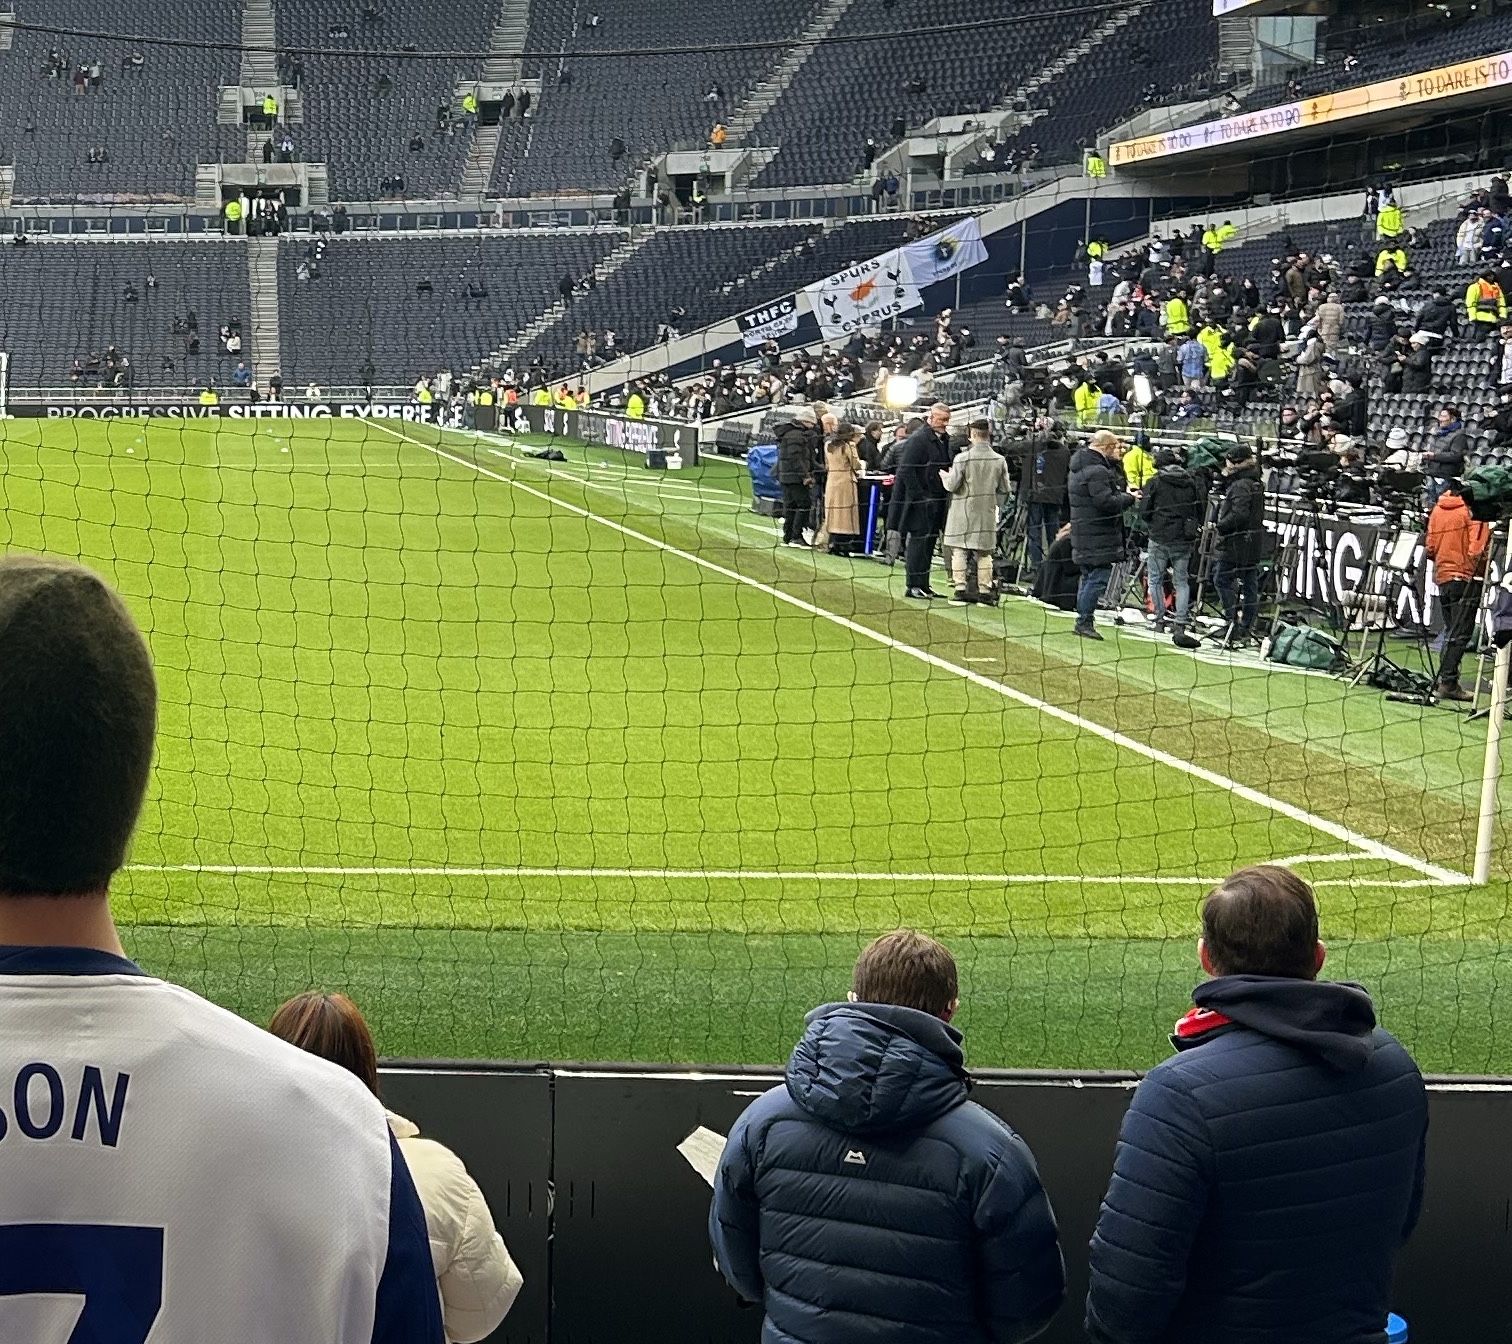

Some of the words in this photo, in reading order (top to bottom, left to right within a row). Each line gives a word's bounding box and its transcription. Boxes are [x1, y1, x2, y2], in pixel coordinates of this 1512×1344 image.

[1417, 78, 1434, 97] TO
[1437, 69, 1471, 92] DARE
[1475, 64, 1487, 84] IS
[1489, 60, 1509, 82] TO
[1221, 124, 1233, 140] TO
[1233, 117, 1258, 136] DARE
[1259, 115, 1269, 130] IS
[1271, 112, 1284, 128] TO
[1285, 107, 1300, 126] DO
[1126, 144, 1136, 158] TO
[1137, 140, 1158, 156] DARE
[1158, 138, 1166, 151] IS
[1167, 135, 1178, 150] TO
[1179, 133, 1192, 148] DO
[830, 259, 881, 287] SPURS
[744, 301, 793, 328] THFC
[841, 301, 903, 332] CYPRUS
